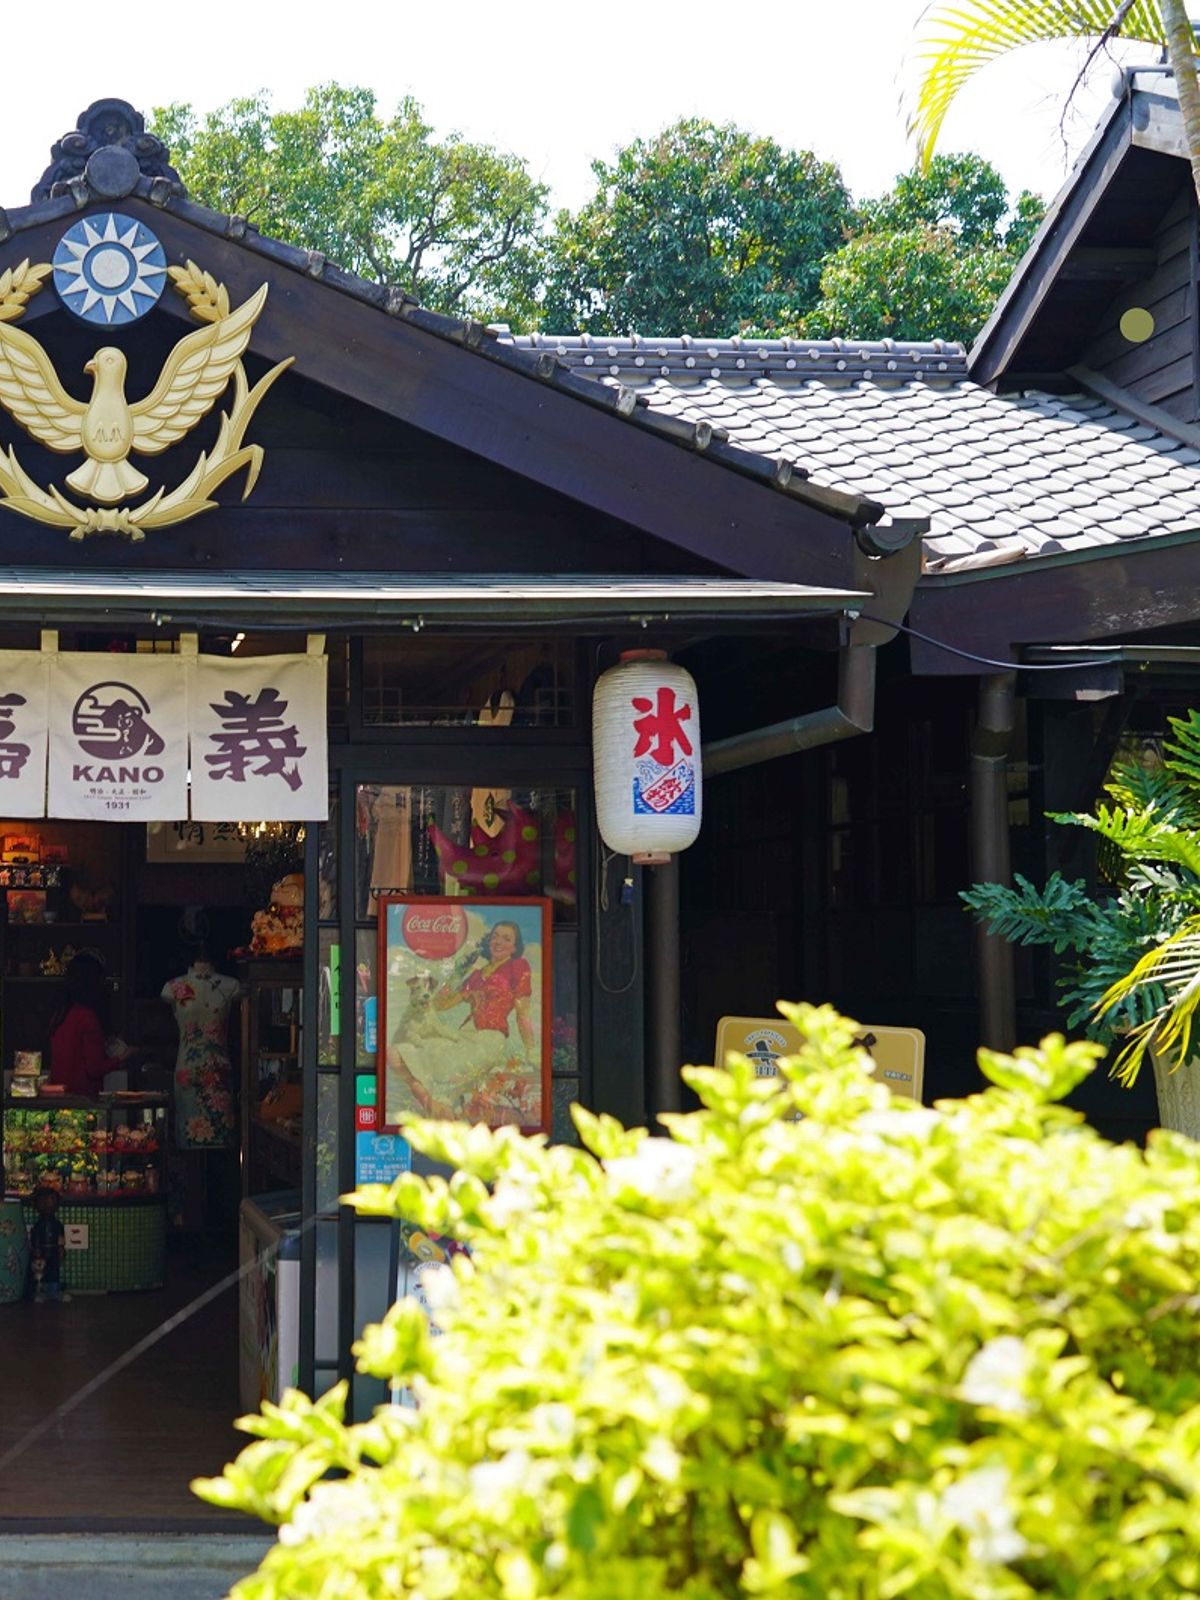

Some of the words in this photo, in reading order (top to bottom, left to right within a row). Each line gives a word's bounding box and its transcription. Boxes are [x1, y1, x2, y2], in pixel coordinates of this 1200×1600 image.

[204, 687, 307, 792] 義
[72, 765, 164, 783] KANO
[105, 801, 130, 809] 1931
